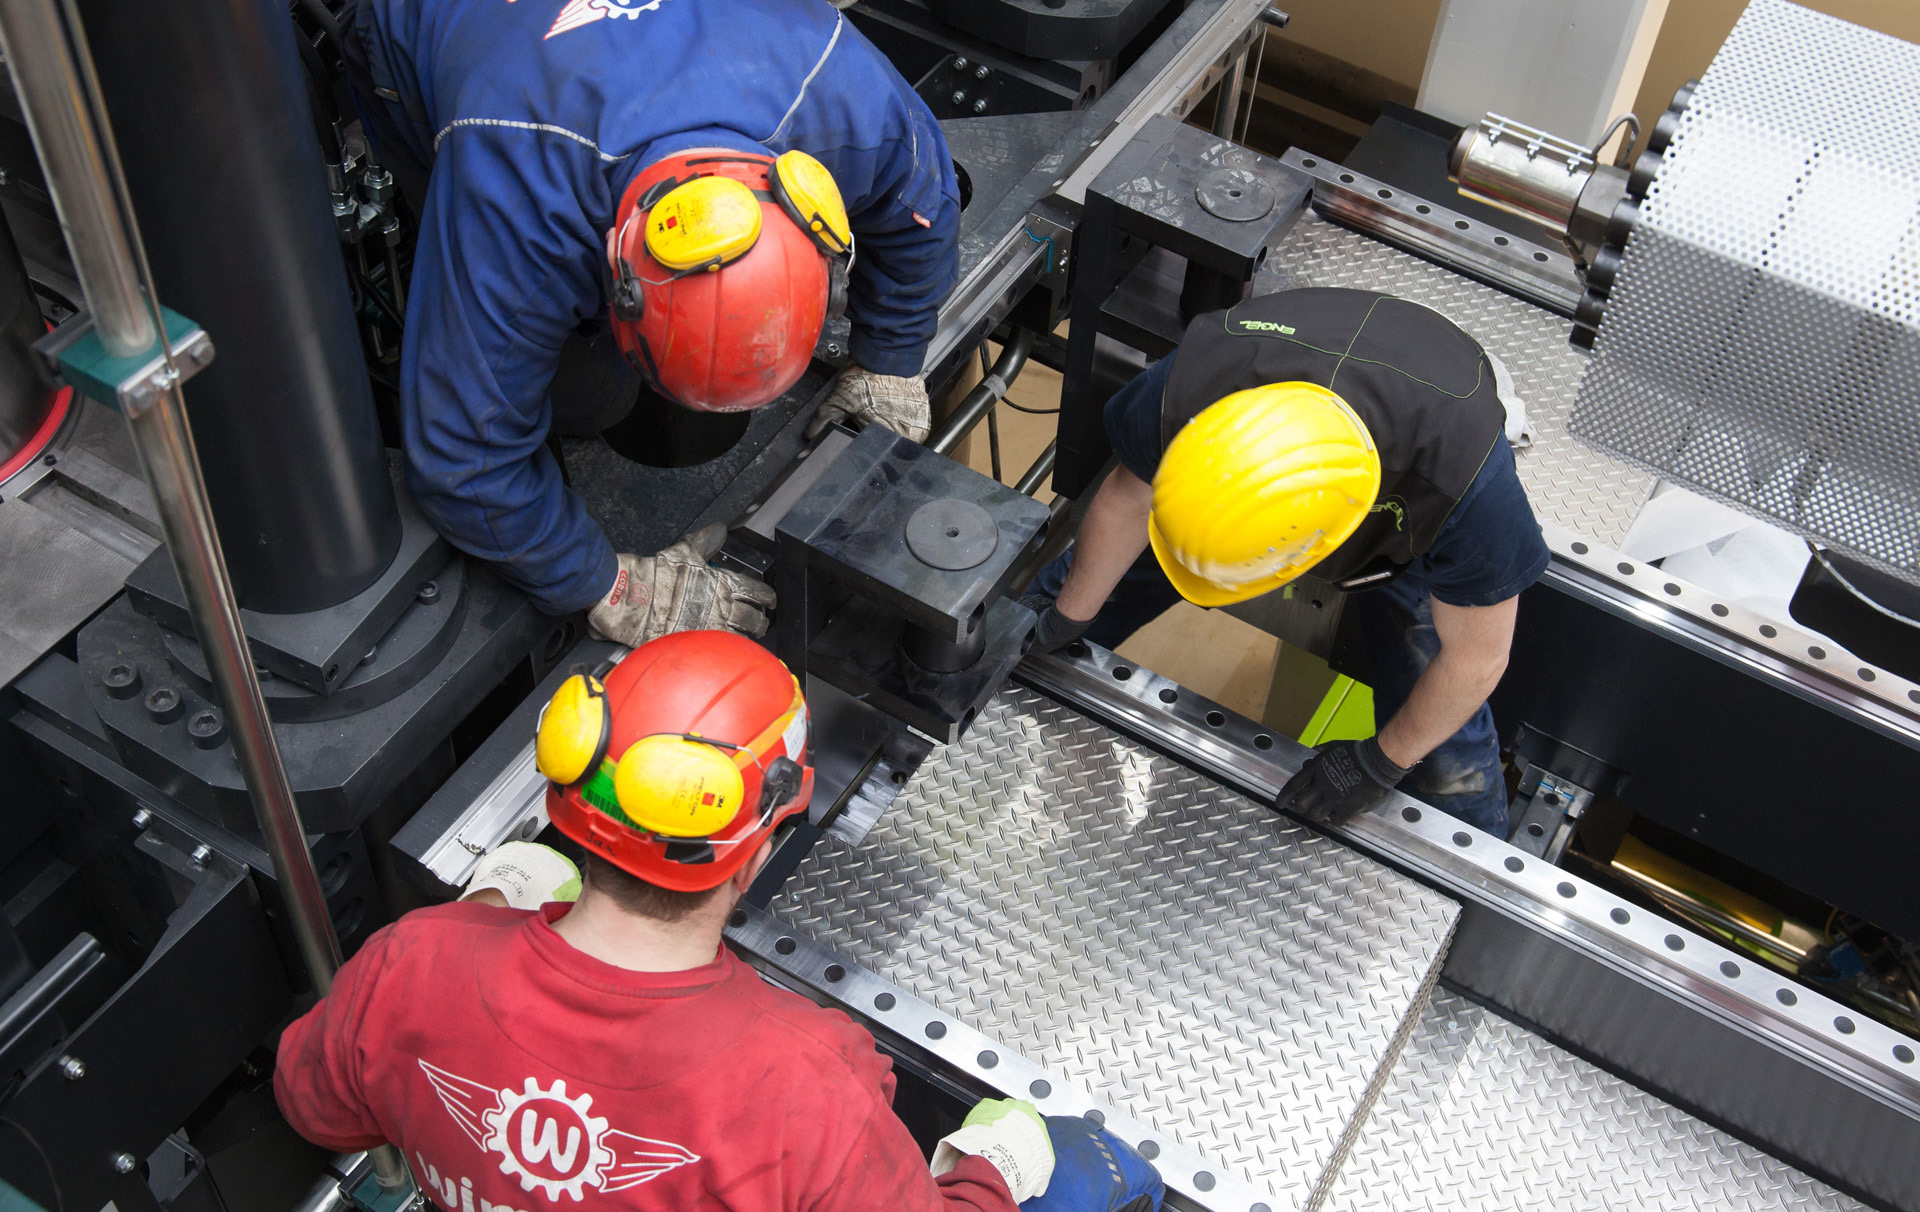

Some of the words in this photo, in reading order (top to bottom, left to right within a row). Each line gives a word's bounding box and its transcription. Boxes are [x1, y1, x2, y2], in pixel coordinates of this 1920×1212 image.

[1239, 320, 1296, 335] ENGEL
[611, 573, 627, 603] COBRA
[980, 1149, 998, 1161] CE
